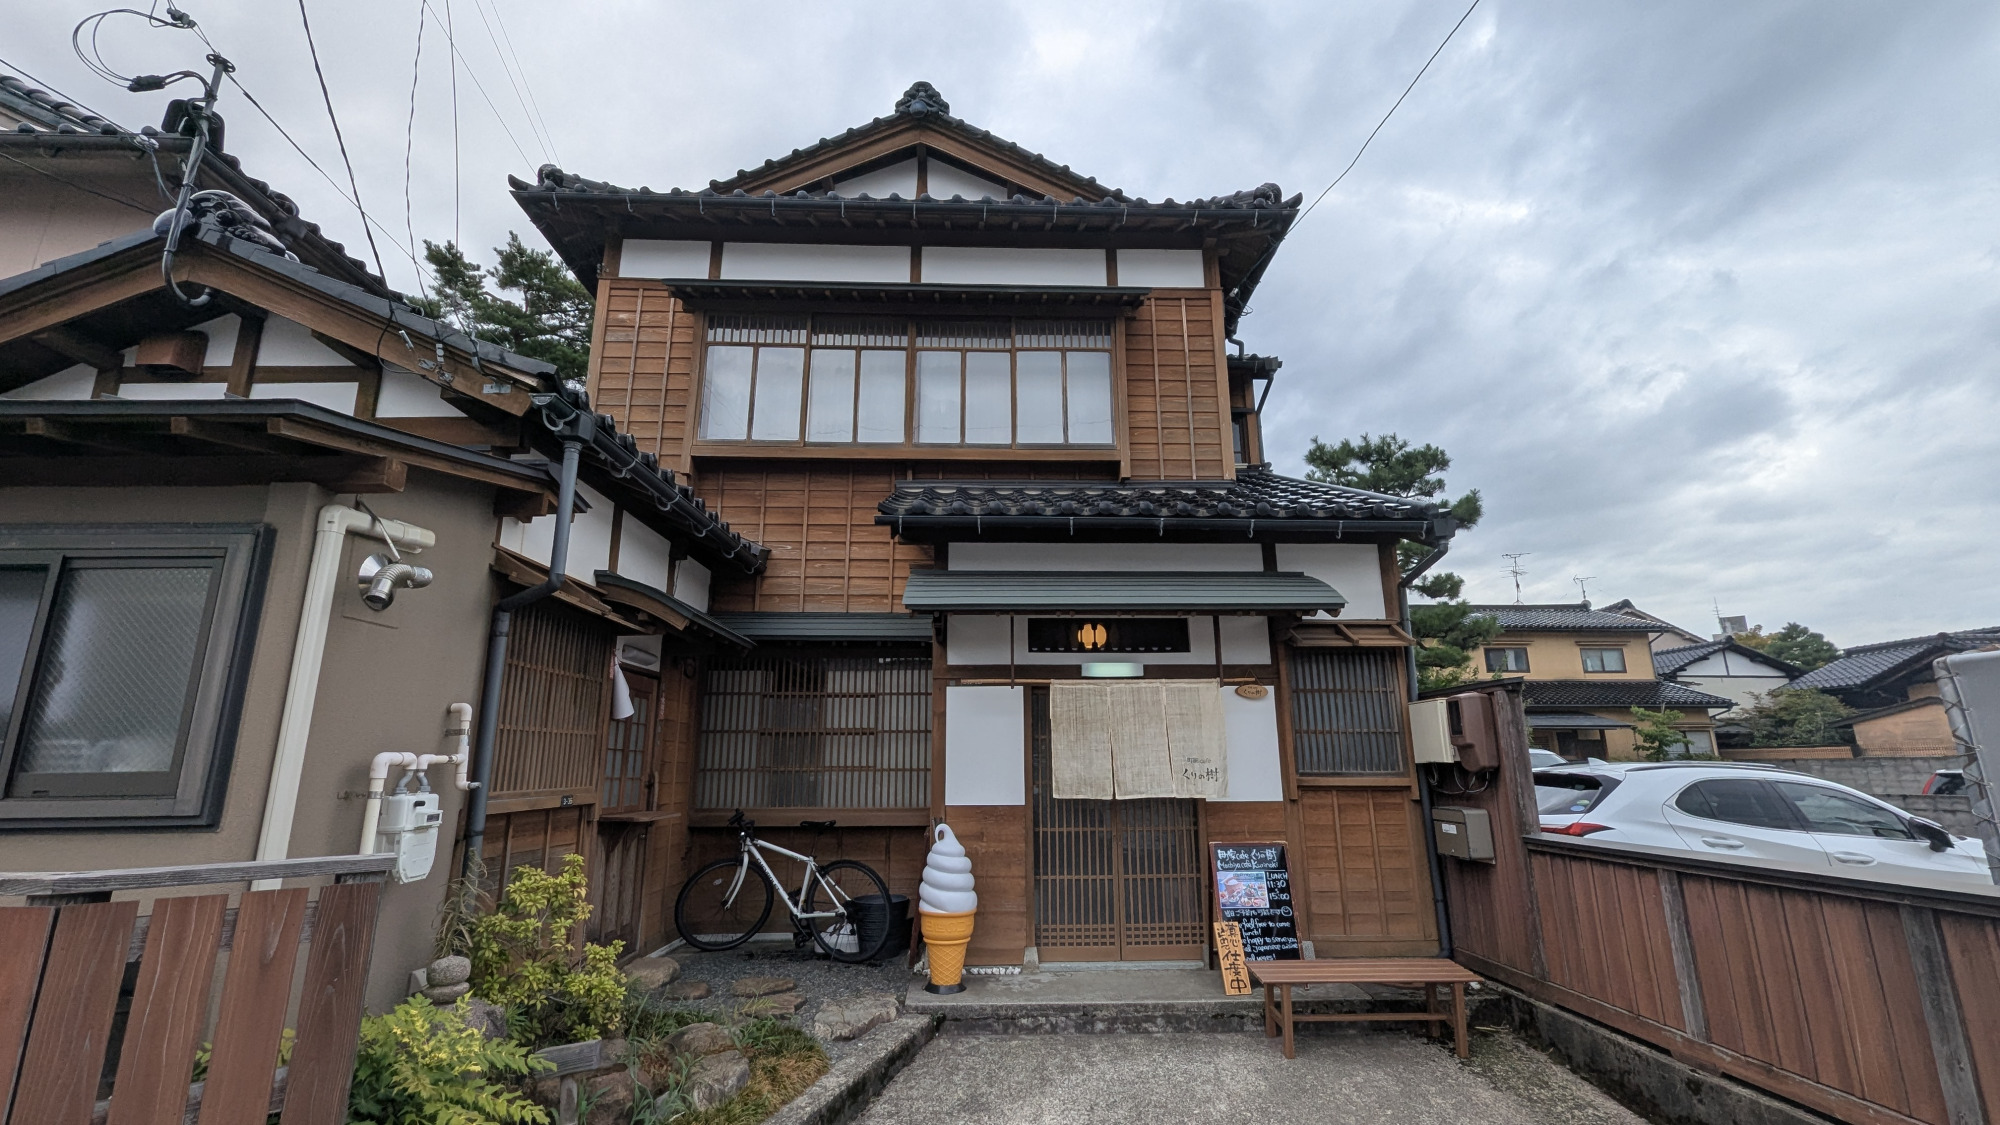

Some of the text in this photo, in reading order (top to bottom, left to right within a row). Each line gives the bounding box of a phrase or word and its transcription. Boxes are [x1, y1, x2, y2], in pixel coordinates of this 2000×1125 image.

[1182, 767, 1219, 782] くりの樹
[1276, 921, 1291, 929] come
[1246, 936, 1264, 946] happy
[1252, 944, 1282, 953] Japanese
[1222, 950, 1248, 993] 仕度中
